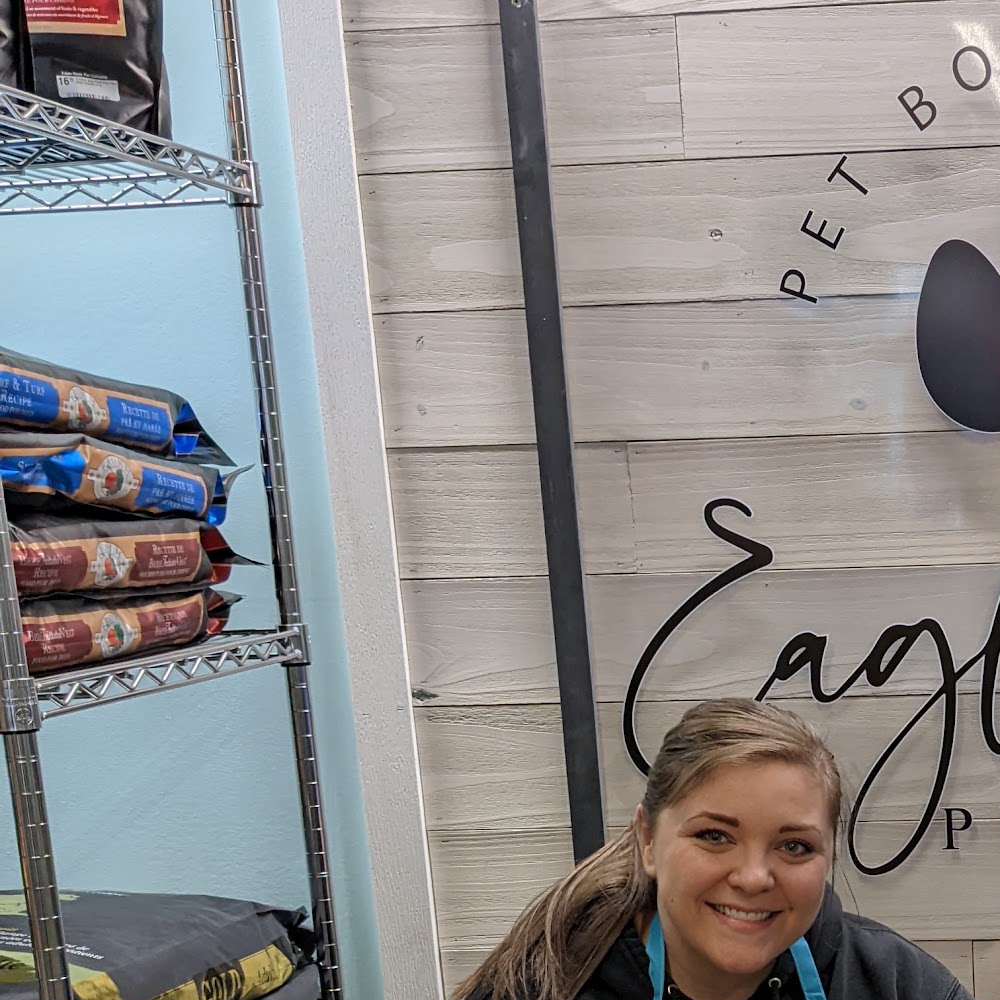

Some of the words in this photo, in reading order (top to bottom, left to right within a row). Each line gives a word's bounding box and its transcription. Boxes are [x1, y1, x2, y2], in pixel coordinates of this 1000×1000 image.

[59, 76, 70, 85] 16
[779, 155, 869, 304] PET
[12, 377, 20, 391] &
[23, 379, 46, 396] TURF
[156, 472, 187, 491] RECETTE
